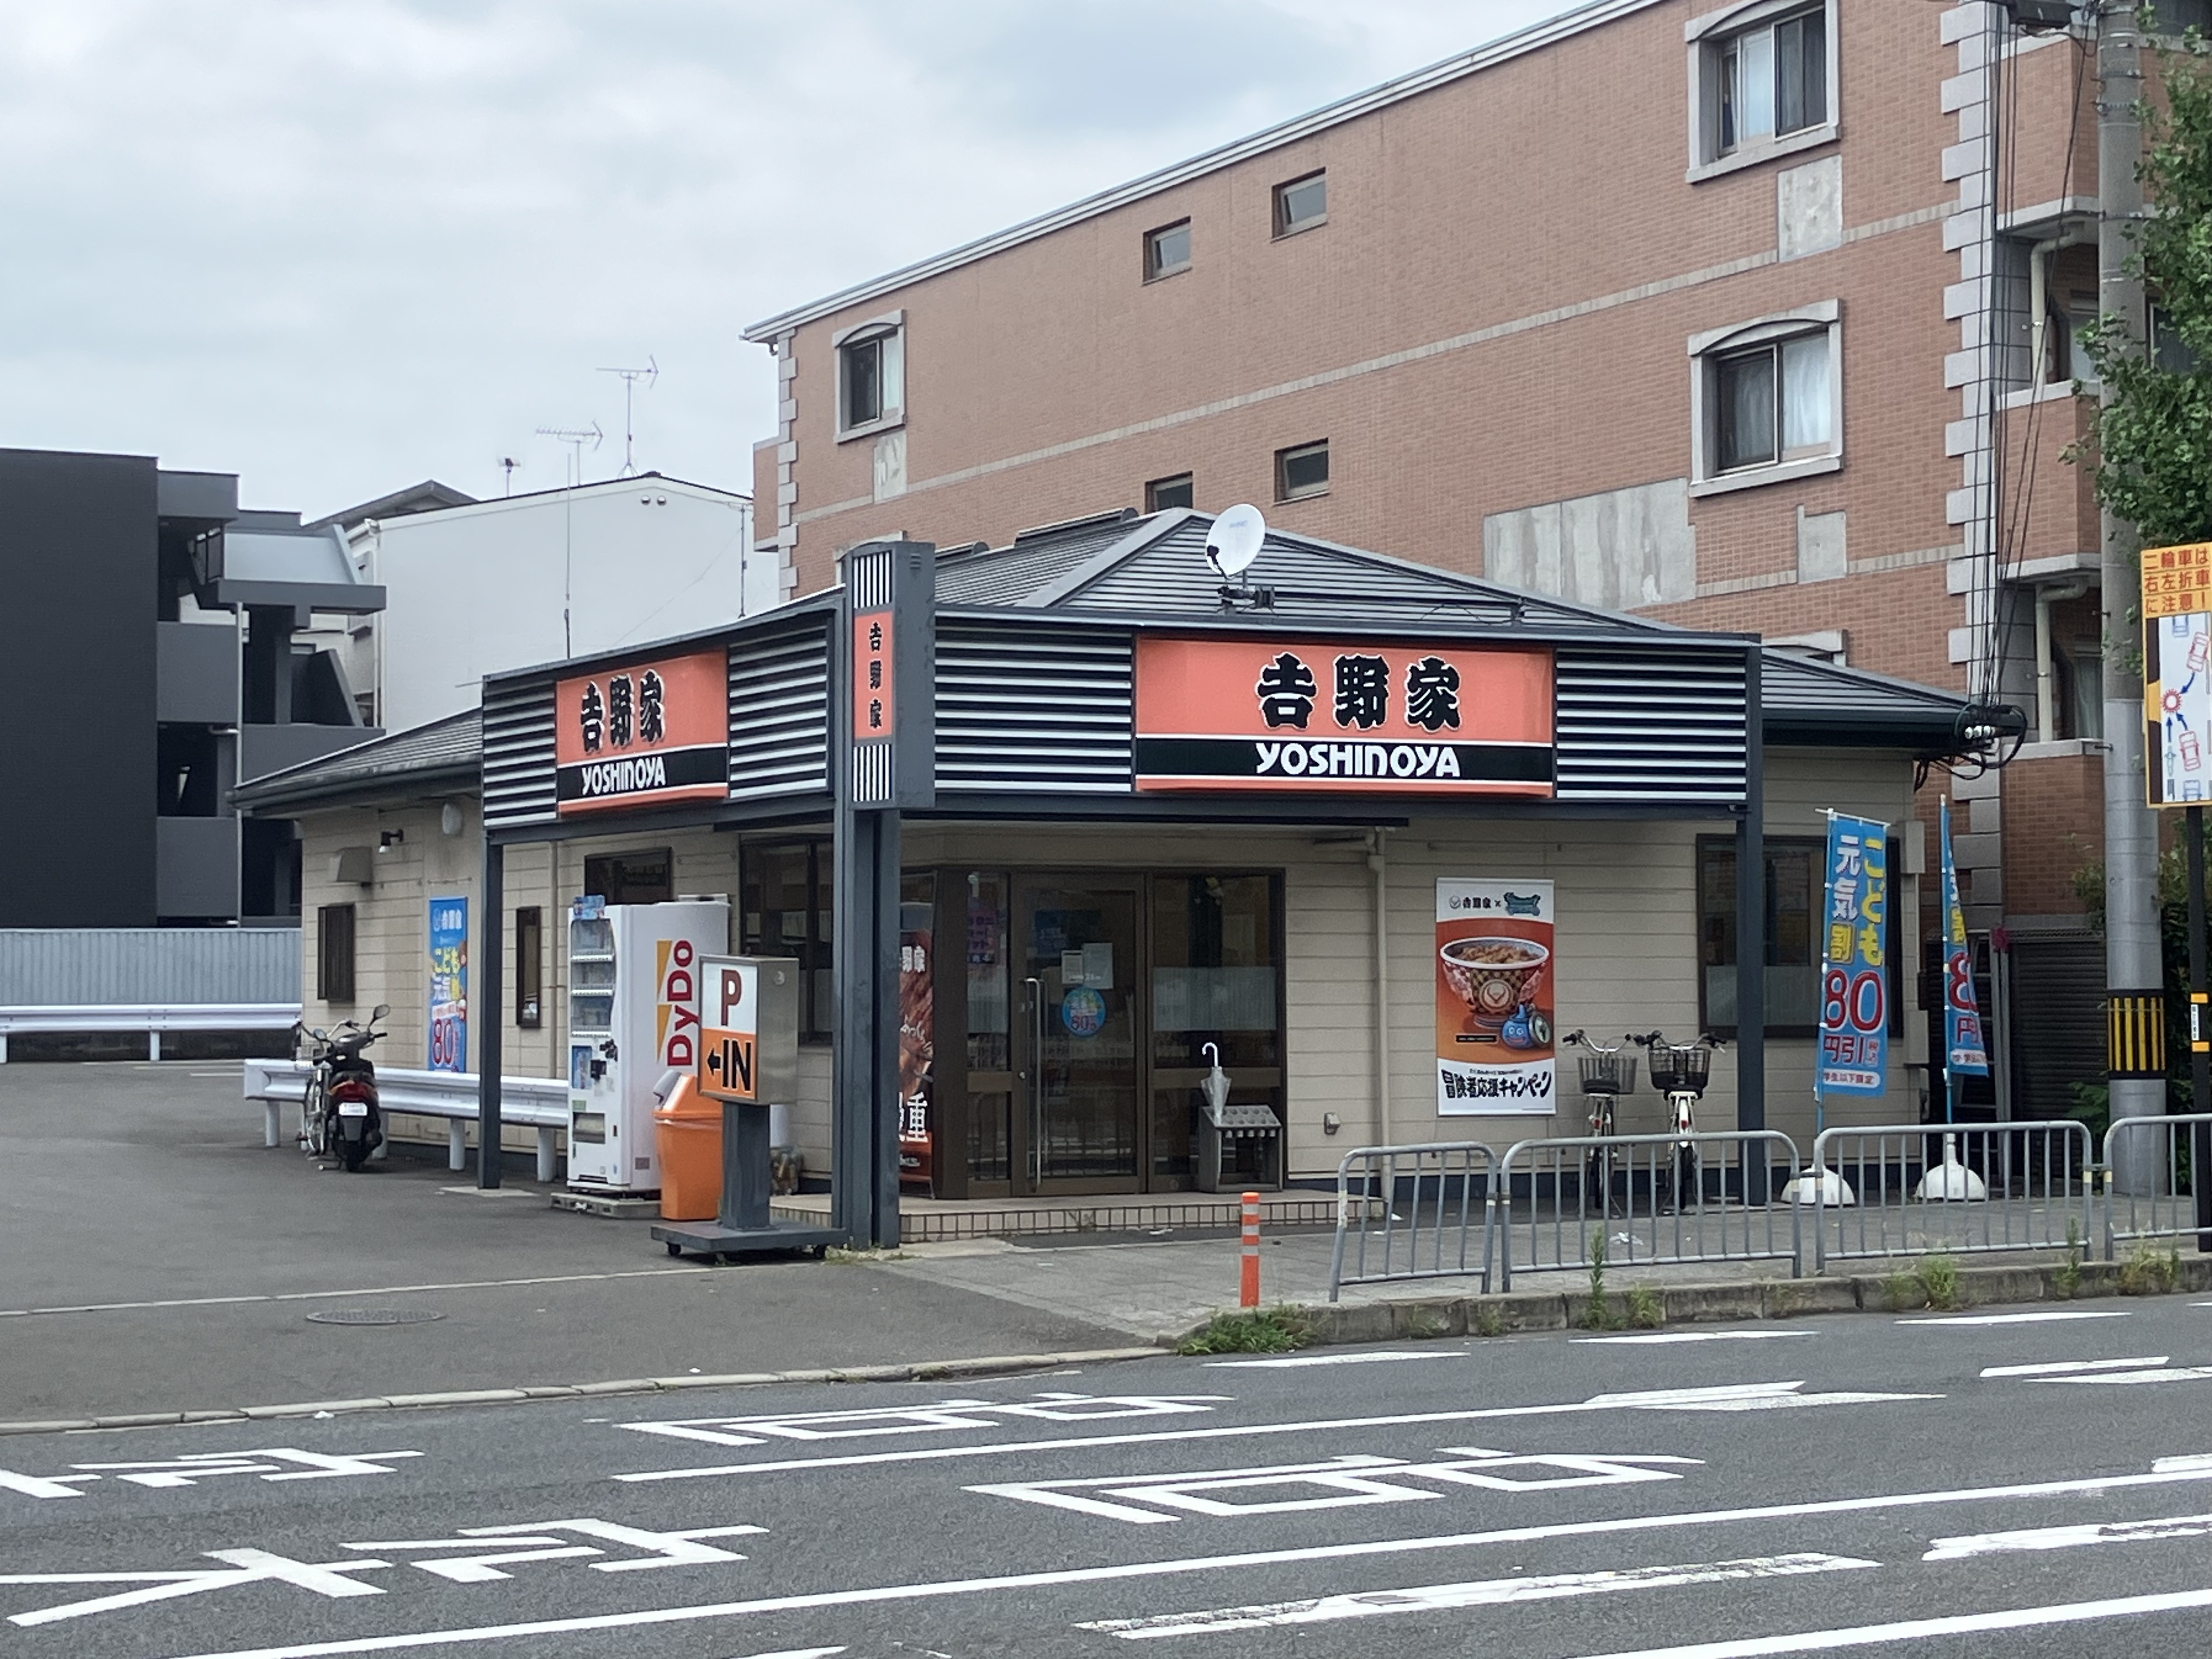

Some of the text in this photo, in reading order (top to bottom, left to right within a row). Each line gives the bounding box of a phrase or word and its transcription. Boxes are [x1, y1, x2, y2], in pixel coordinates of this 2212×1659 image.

[2144, 548, 2209, 570] 二輪車は
[2145, 569, 2210, 593] 右左折車
[869, 622, 883, 729] 吉野家
[1255, 651, 1462, 733] 吉野家
[580, 669, 666, 753] 吉野家
[581, 756, 667, 795] YOSHINOYA
[1256, 742, 1461, 777] YOSHINOYA
[1859, 838, 1884, 967] こども
[435, 946, 460, 974] こども
[721, 969, 743, 1026] P
[1825, 968, 1884, 1035] 80
[432, 1019, 454, 1064] 80
[721, 1039, 752, 1091] IN
